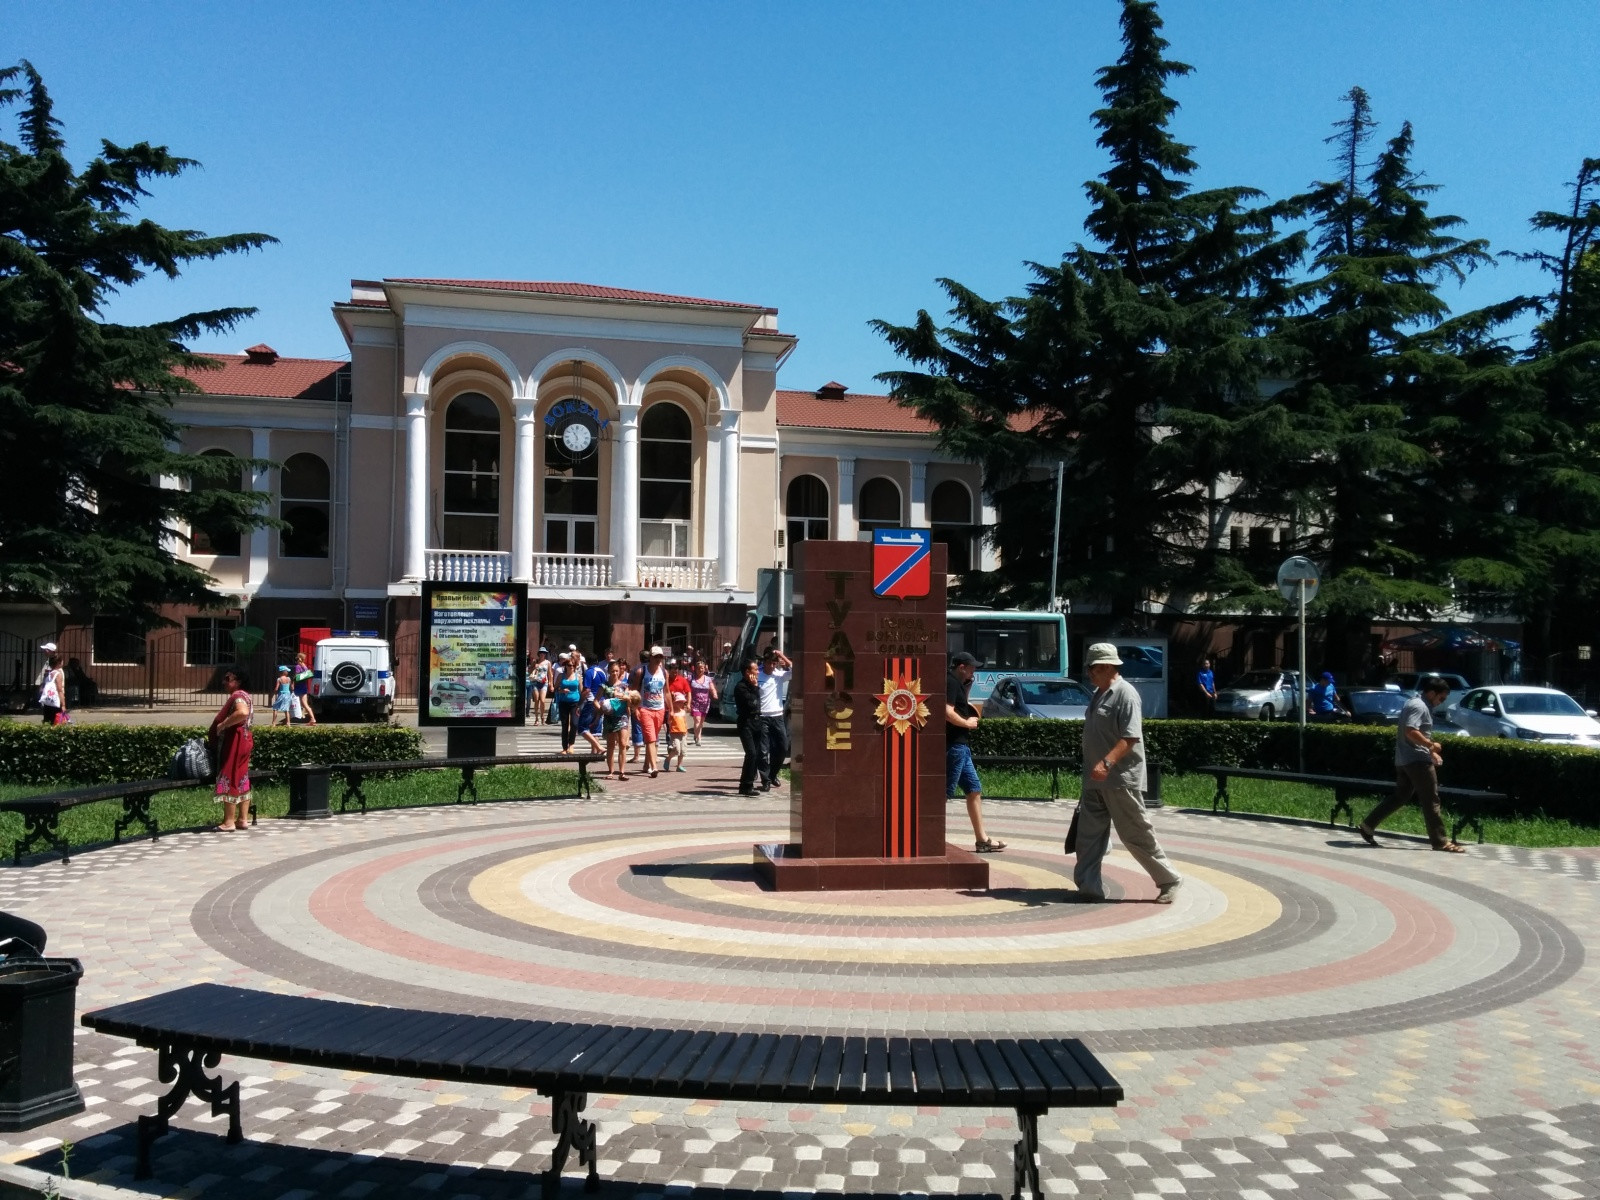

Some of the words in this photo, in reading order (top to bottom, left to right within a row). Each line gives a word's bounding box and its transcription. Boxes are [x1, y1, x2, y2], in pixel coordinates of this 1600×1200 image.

[544, 401, 609, 430] ВОКЗАЛ
[880, 617, 925, 630] ГОРОД
[866, 630, 939, 642] ВОИНСКОЙ
[879, 644, 927, 655] СЛАВЫ
[824, 571, 855, 750] ТУАПСЕ
